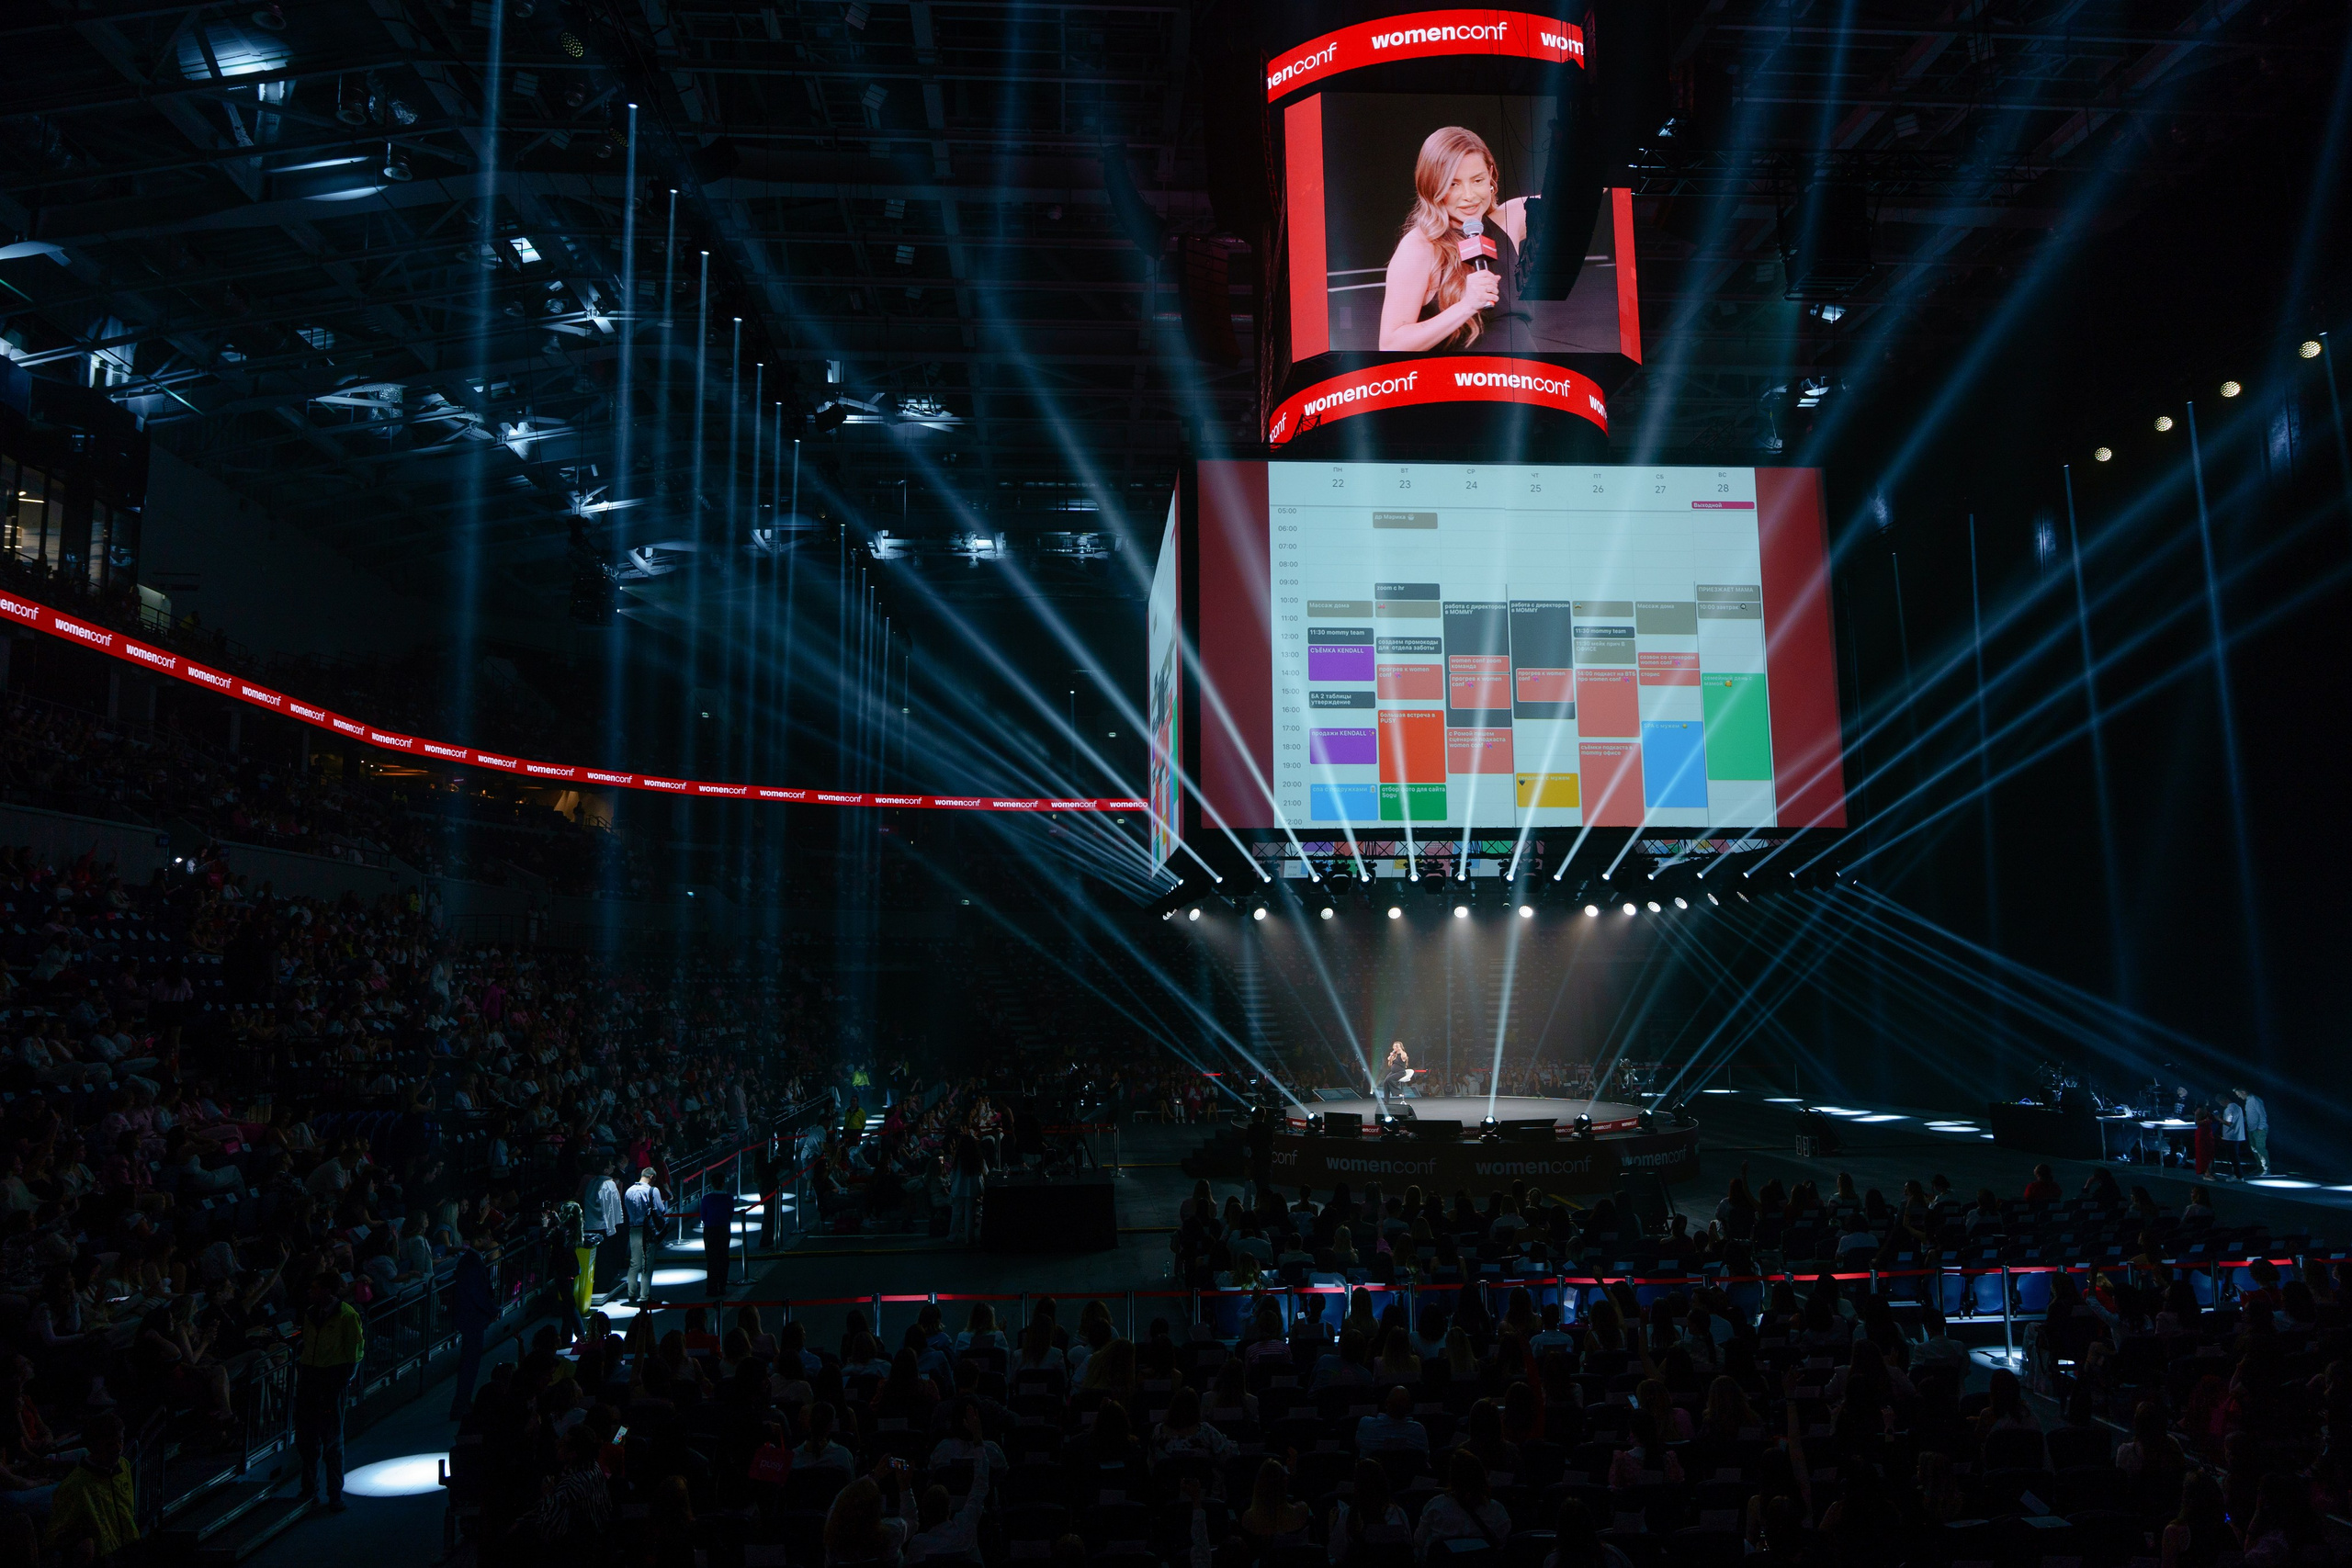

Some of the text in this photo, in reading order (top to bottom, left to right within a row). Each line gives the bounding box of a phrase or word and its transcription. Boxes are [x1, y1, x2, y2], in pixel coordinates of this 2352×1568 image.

[1372, 21, 1508, 50] womenconf
[1304, 371, 1571, 416] womenconf womenconf
[1332, 479, 1344, 488] 22
[1399, 479, 1411, 489] 23
[1465, 480, 1477, 490] 24
[1530, 484, 1542, 492] 25
[1717, 483, 1729, 492] 28
[1592, 485, 1604, 493] 26
[1655, 485, 1667, 493] 27
[0, 598, 40, 621] enconf
[55, 617, 112, 647] womenconf
[126, 643, 176, 670] womenconf
[187, 666, 232, 689] womenconf
[242, 685, 281, 706] womenconf
[290, 703, 325, 722] womenconf
[333, 718, 365, 736] womenconf
[371, 732, 413, 748] womenconf
[424, 743, 468, 759] womenconf
[478, 754, 517, 769] womenconf
[526, 763, 575, 777] womenconf
[587, 771, 633, 784] womenconf
[644, 778, 687, 790] womenconf
[698, 784, 747, 795] womenconf
[760, 789, 806, 799] womenconf
[817, 793, 862, 803] womenconf
[875, 796, 922, 805] womenconf
[935, 798, 981, 807] womenconf
[993, 800, 1039, 809] womenconf
[1051, 800, 1097, 809] womenconf
[1326, 1157, 1437, 1175] womenconf
[1475, 1155, 1592, 1175] womenconf
[1621, 1144, 1687, 1167] womenconf
